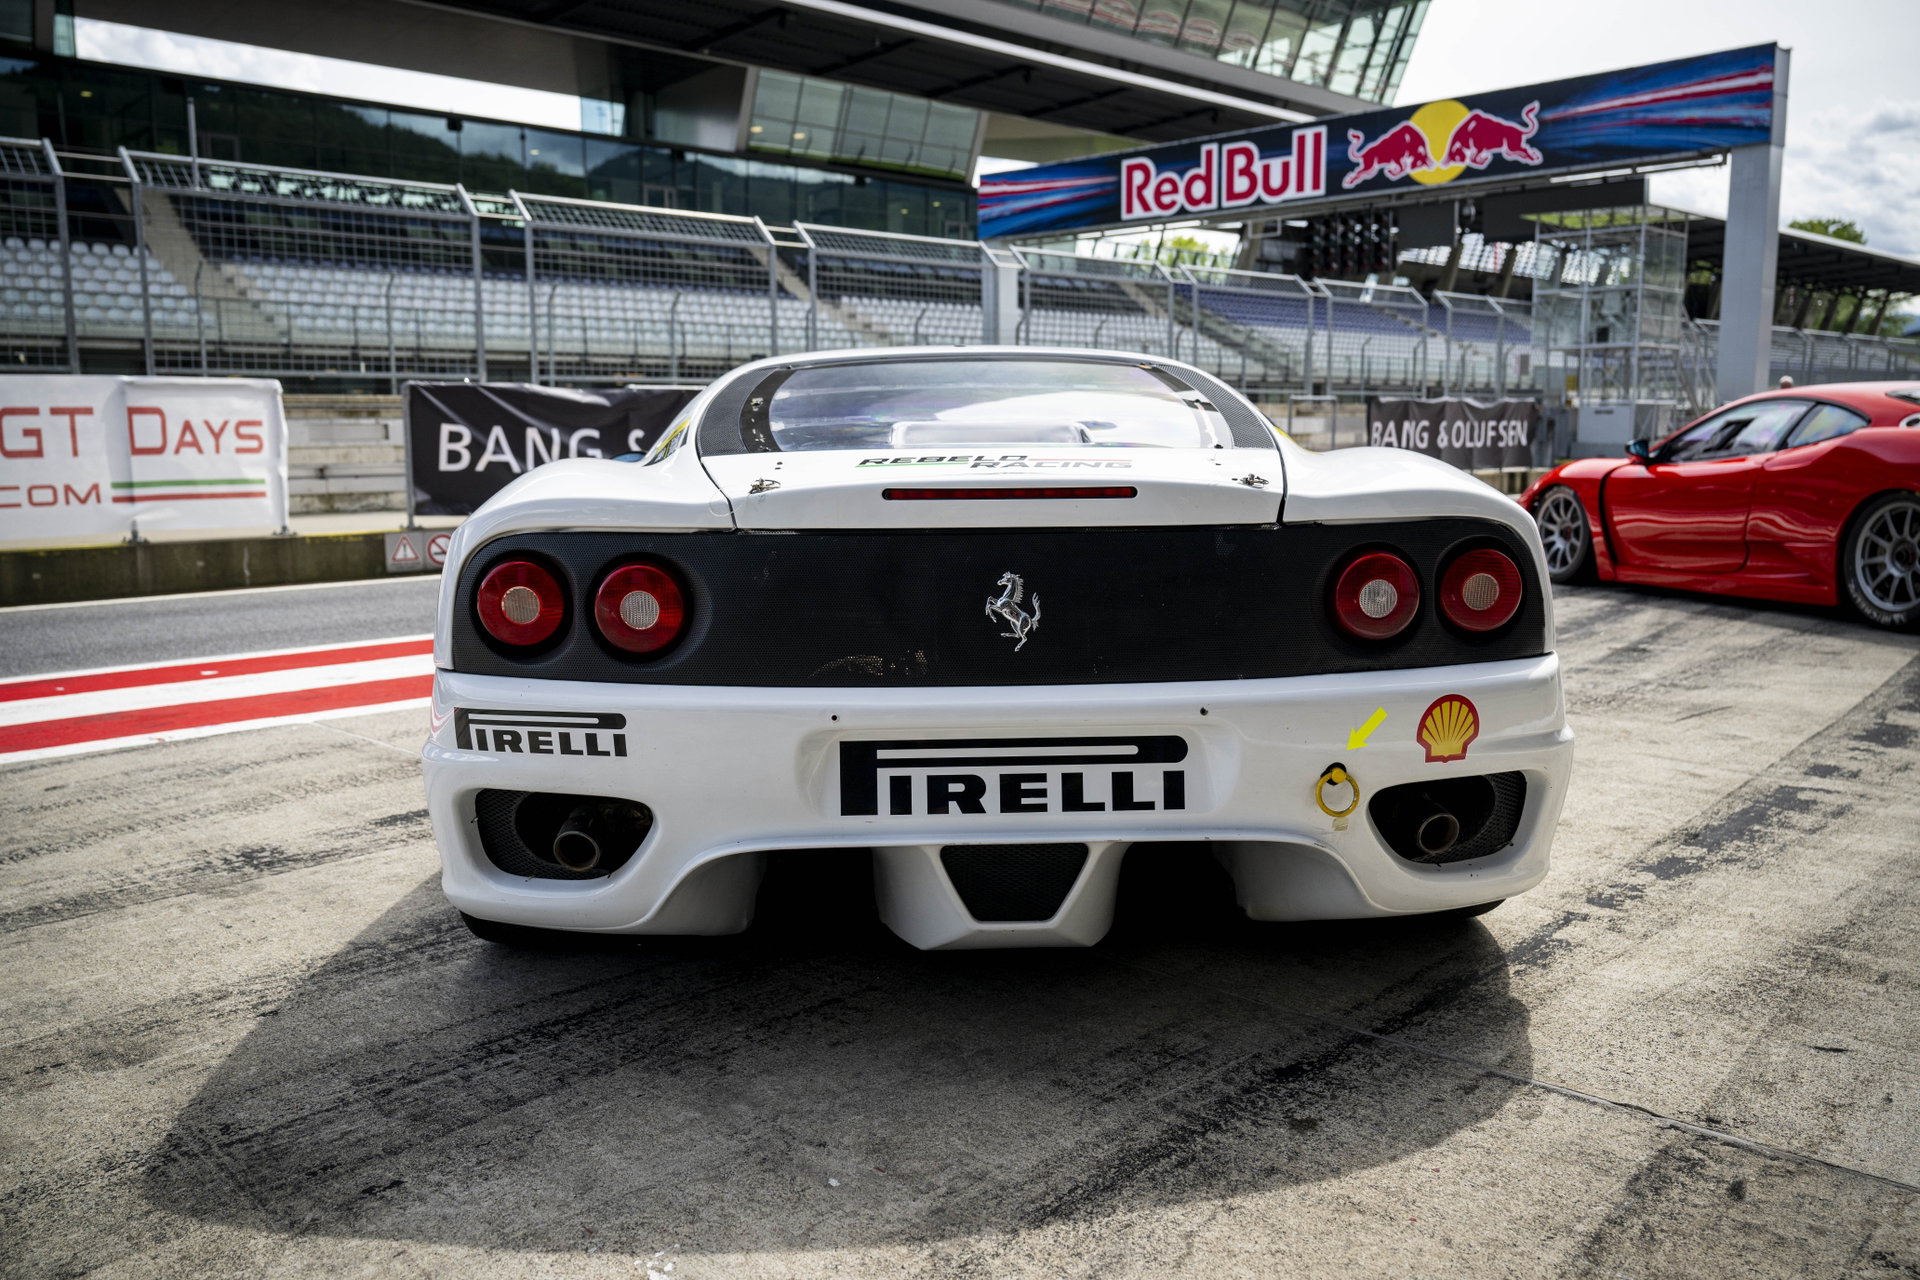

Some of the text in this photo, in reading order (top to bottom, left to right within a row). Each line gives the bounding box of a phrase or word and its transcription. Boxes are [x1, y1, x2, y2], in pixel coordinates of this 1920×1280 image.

[1123, 128, 1325, 218] Red Bull
[0, 407, 94, 458] GT
[1371, 420, 1528, 449] BANG & OLUFSEN
[858, 455, 1028, 466] REBELO
[970, 461, 1133, 469] RACING
[454, 706, 628, 757] PIRELLI
[840, 735, 1189, 816] PIRELLI
